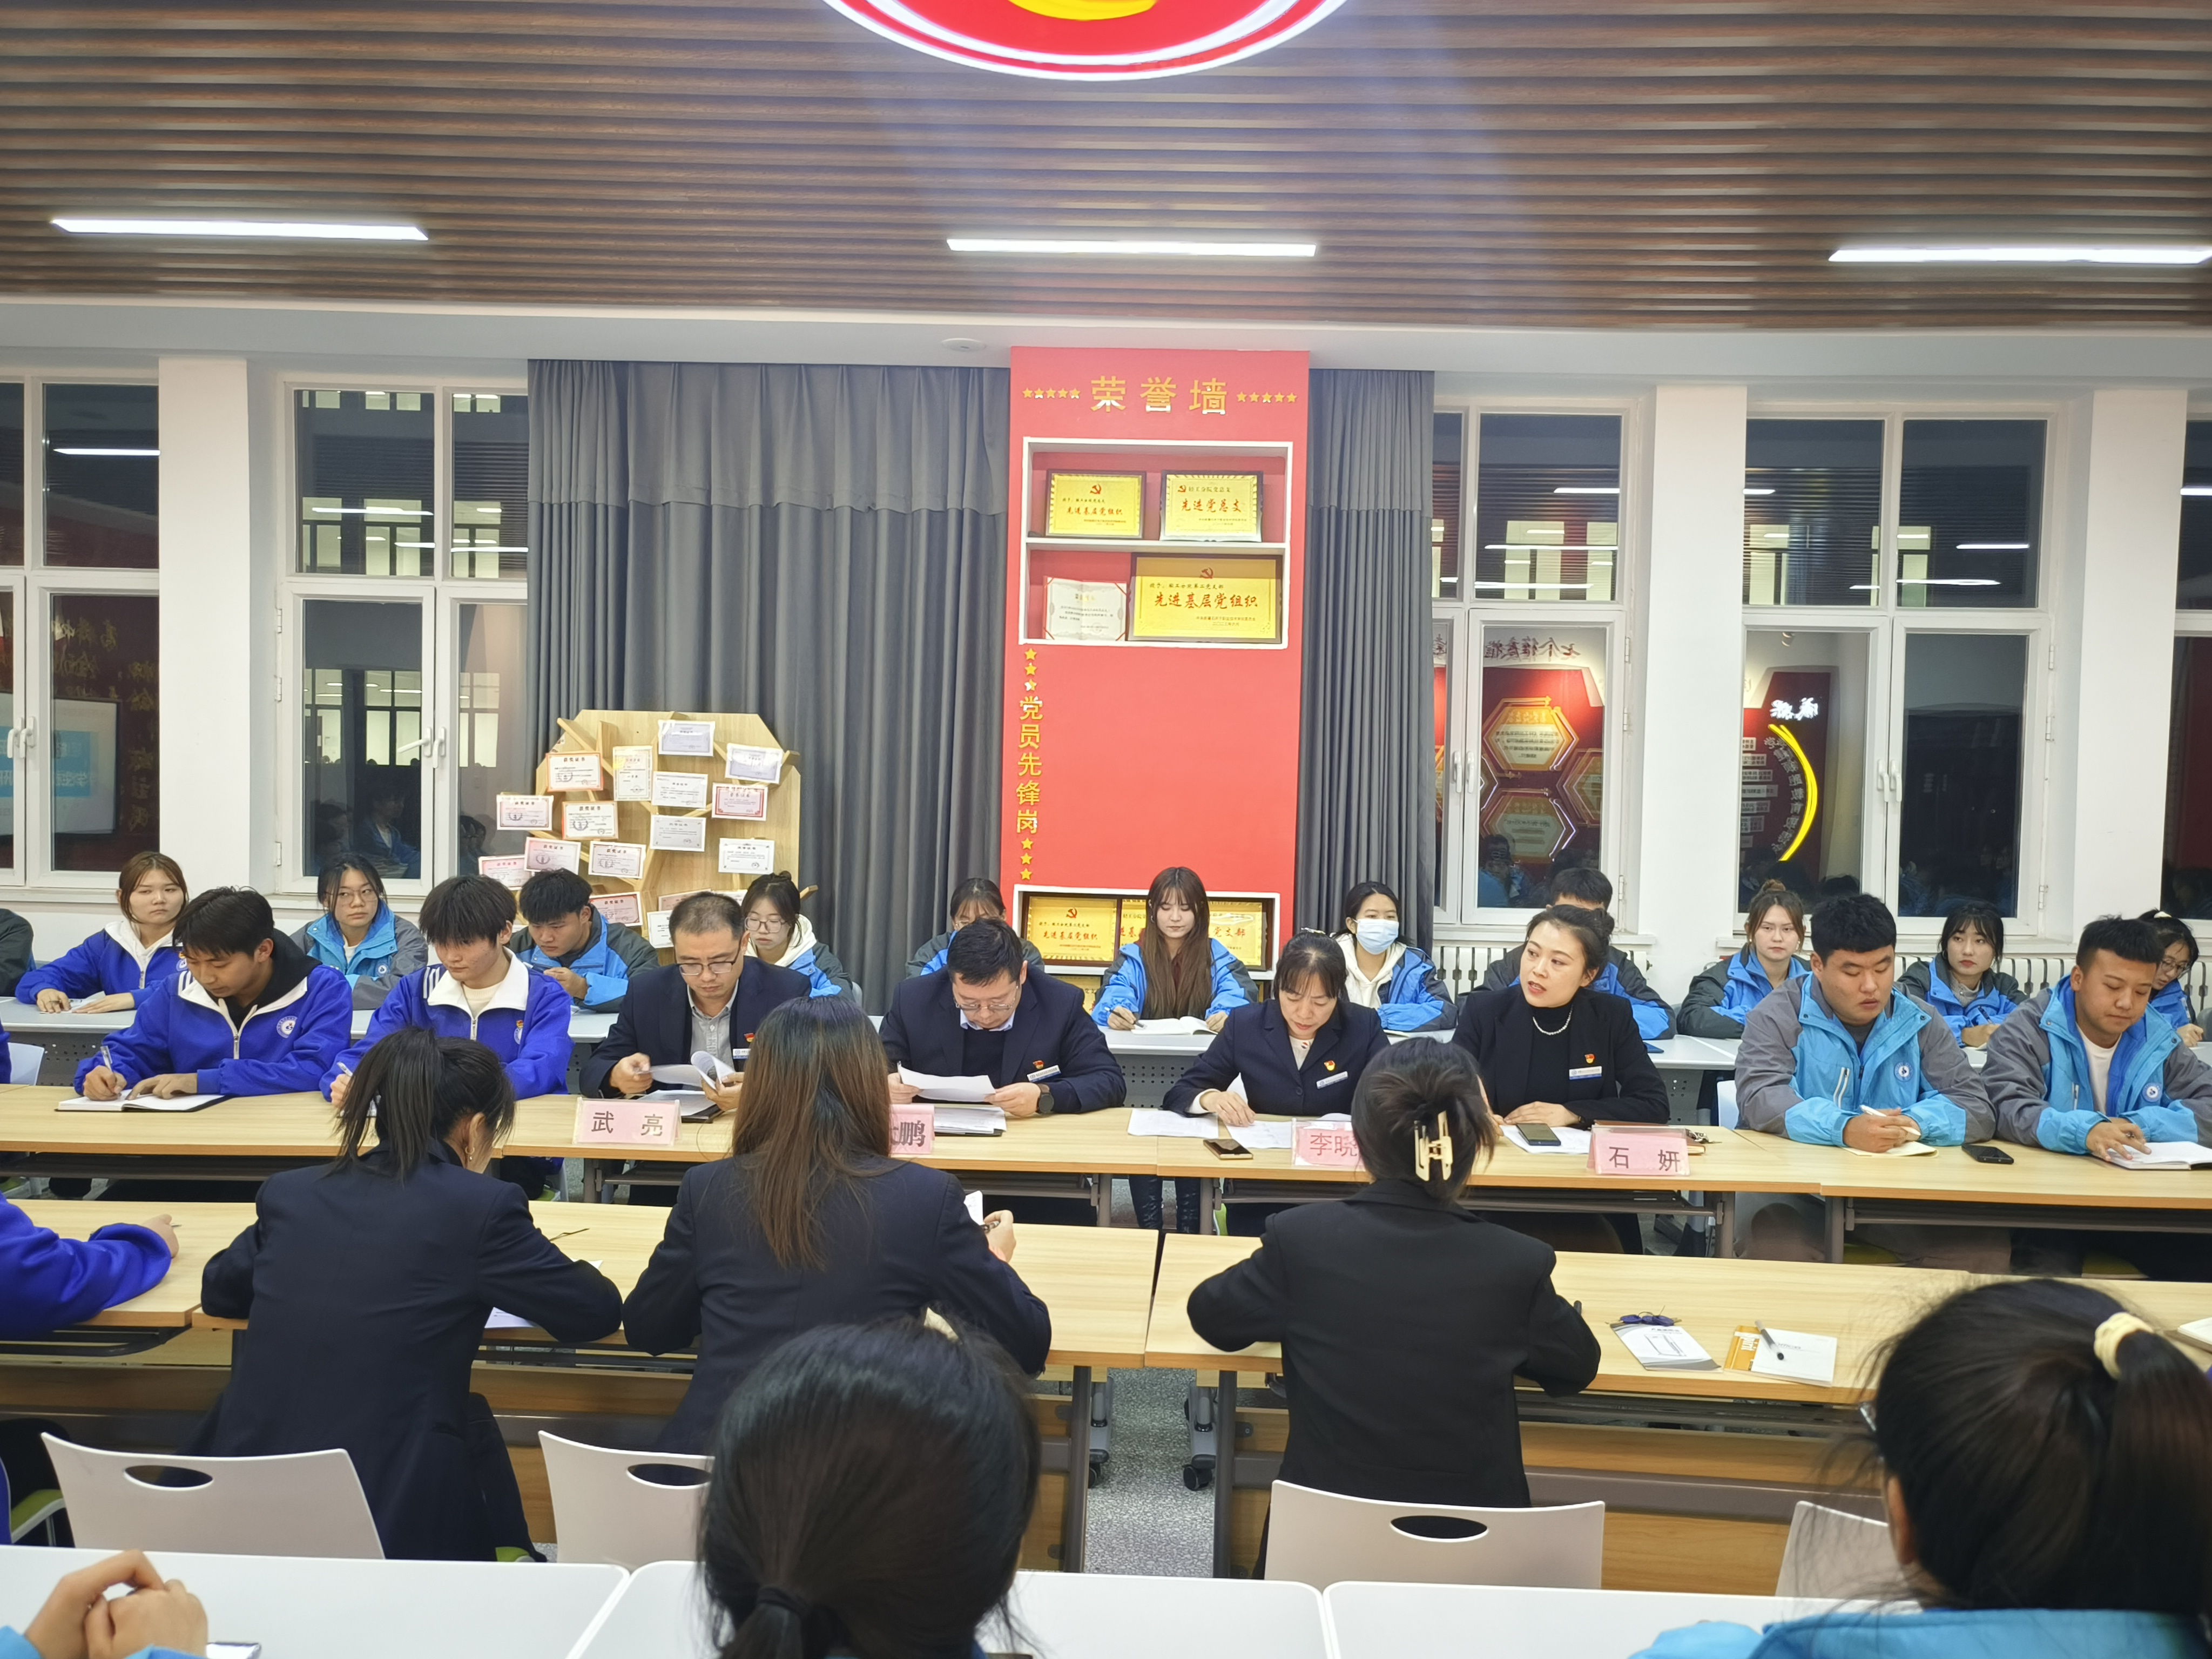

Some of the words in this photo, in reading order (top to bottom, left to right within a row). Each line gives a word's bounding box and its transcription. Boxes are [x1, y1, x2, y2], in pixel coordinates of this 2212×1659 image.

[1090, 375, 1228, 415] 荣誉墙
[1182, 498, 1241, 512] 先进党总支
[1155, 592, 1258, 609] 先进基层党组织
[1016, 696, 1043, 834] 党员先锋岗
[1043, 930, 1098, 941] 先进基层党组织
[591, 1111, 664, 1137] 武亮
[1310, 1133, 1358, 1156] 李晓
[1609, 1146, 1681, 1171] 石妍
